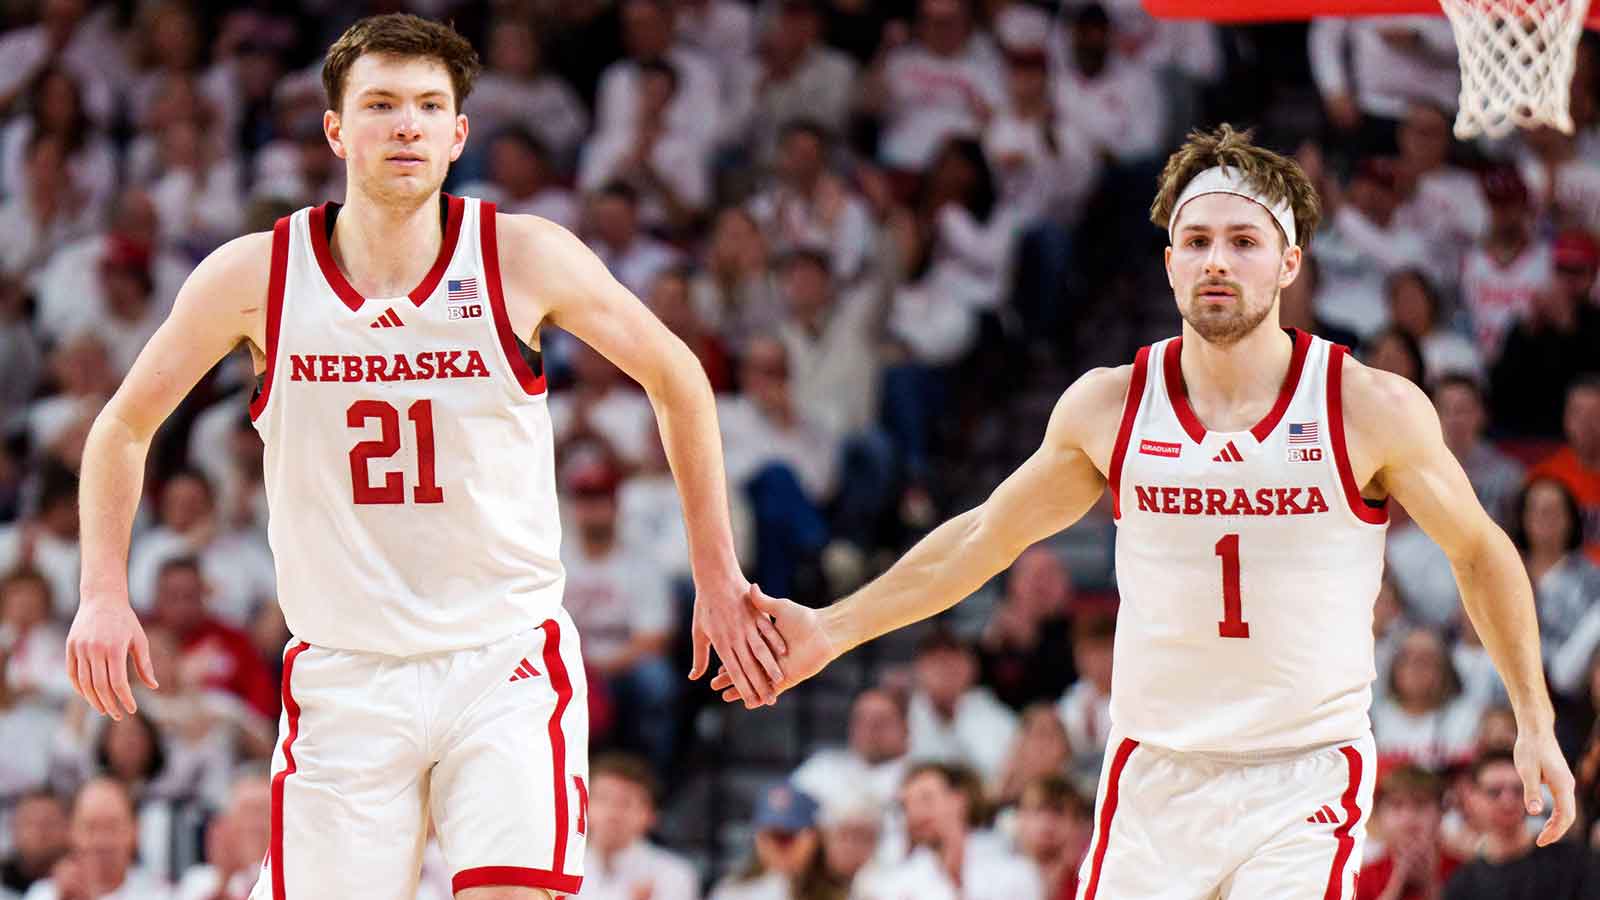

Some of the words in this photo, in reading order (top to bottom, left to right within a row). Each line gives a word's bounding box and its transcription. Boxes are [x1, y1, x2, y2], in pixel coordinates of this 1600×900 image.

[290, 351, 490, 382] NEBRASKA
[346, 399, 444, 504] 21
[1142, 444, 1180, 455] GRADUATE
[1135, 486, 1328, 516] NEBRASKA
[1215, 534, 1249, 638] 1
